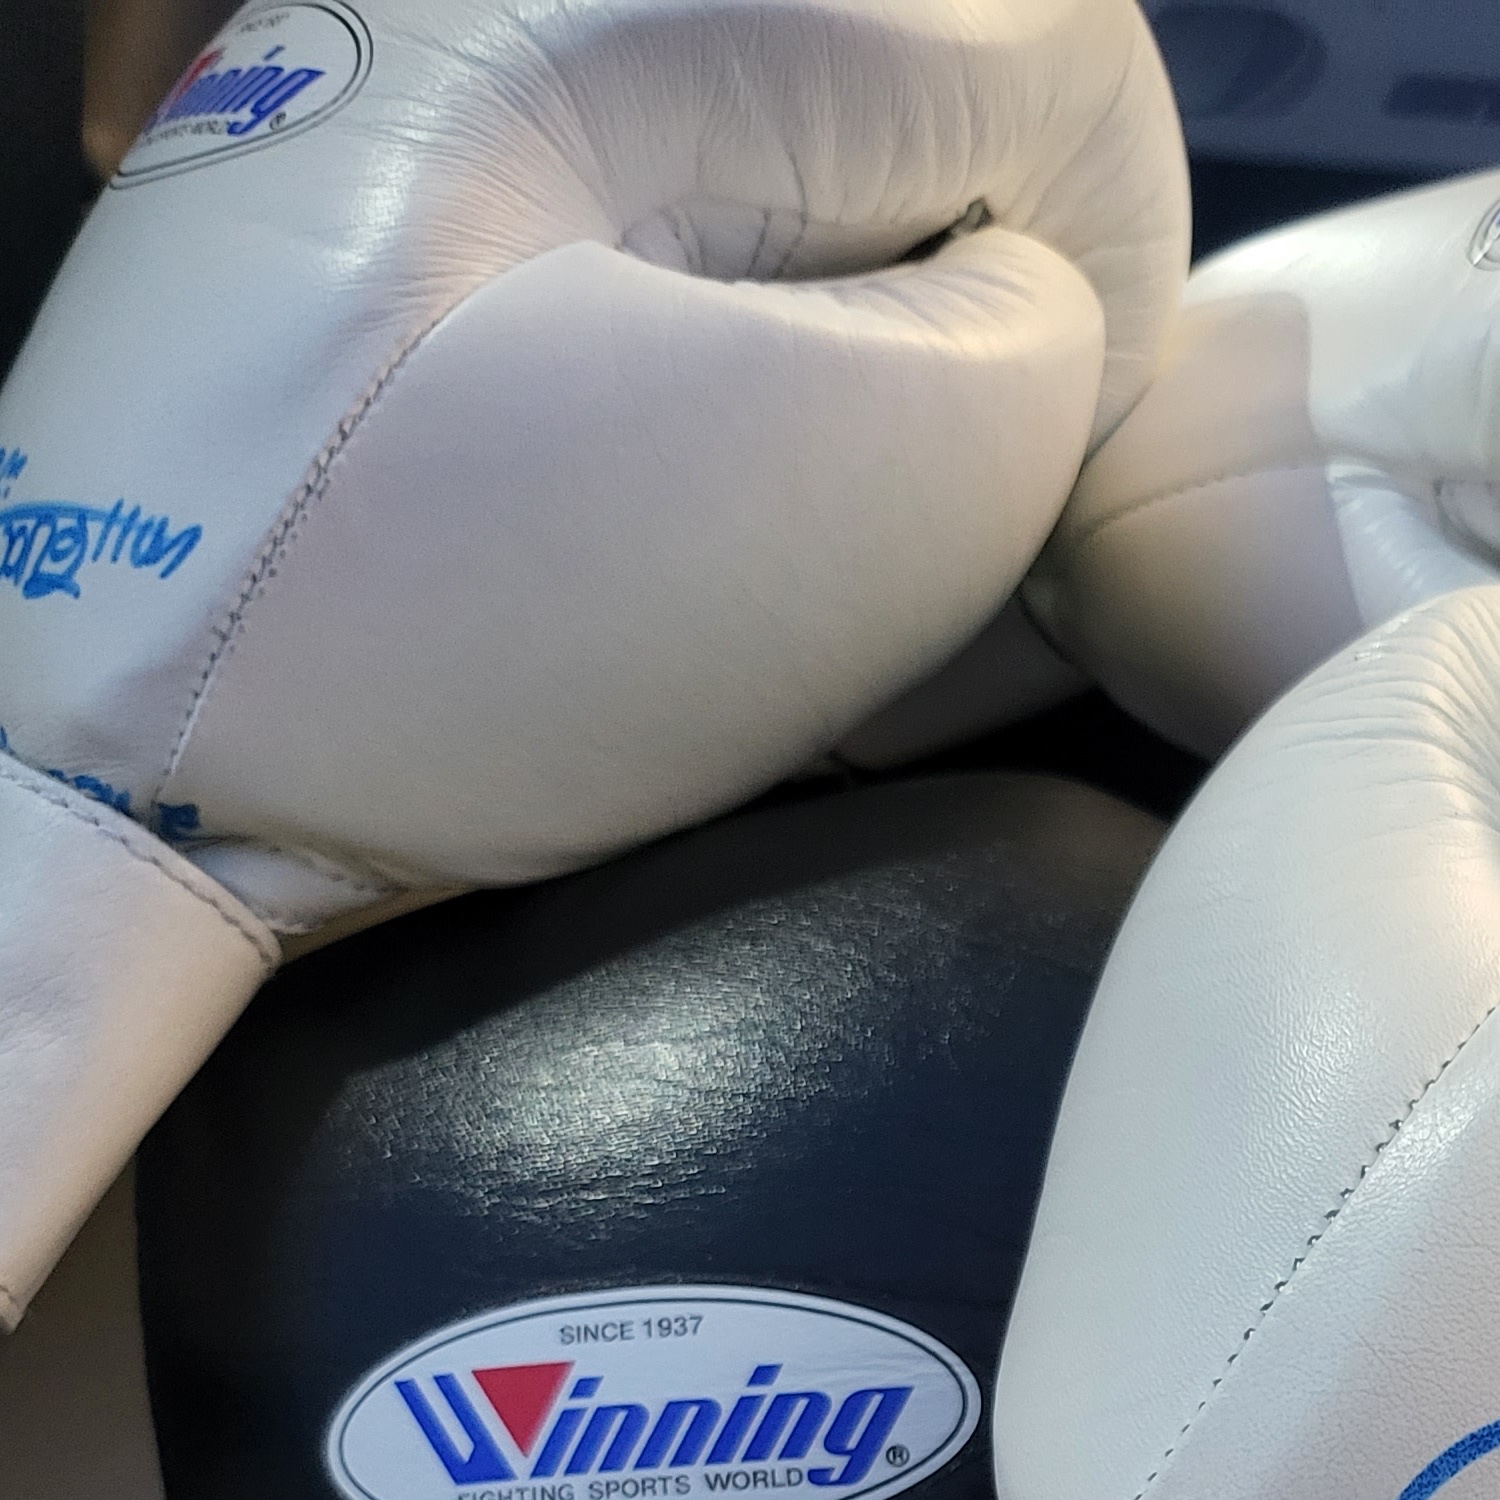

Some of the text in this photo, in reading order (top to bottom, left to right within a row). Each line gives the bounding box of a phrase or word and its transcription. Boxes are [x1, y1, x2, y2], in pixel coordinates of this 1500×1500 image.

[559, 1315, 704, 1346] SINCE 1937
[394, 1360, 914, 1486] Winning
[704, 1468, 803, 1491] WORLD
